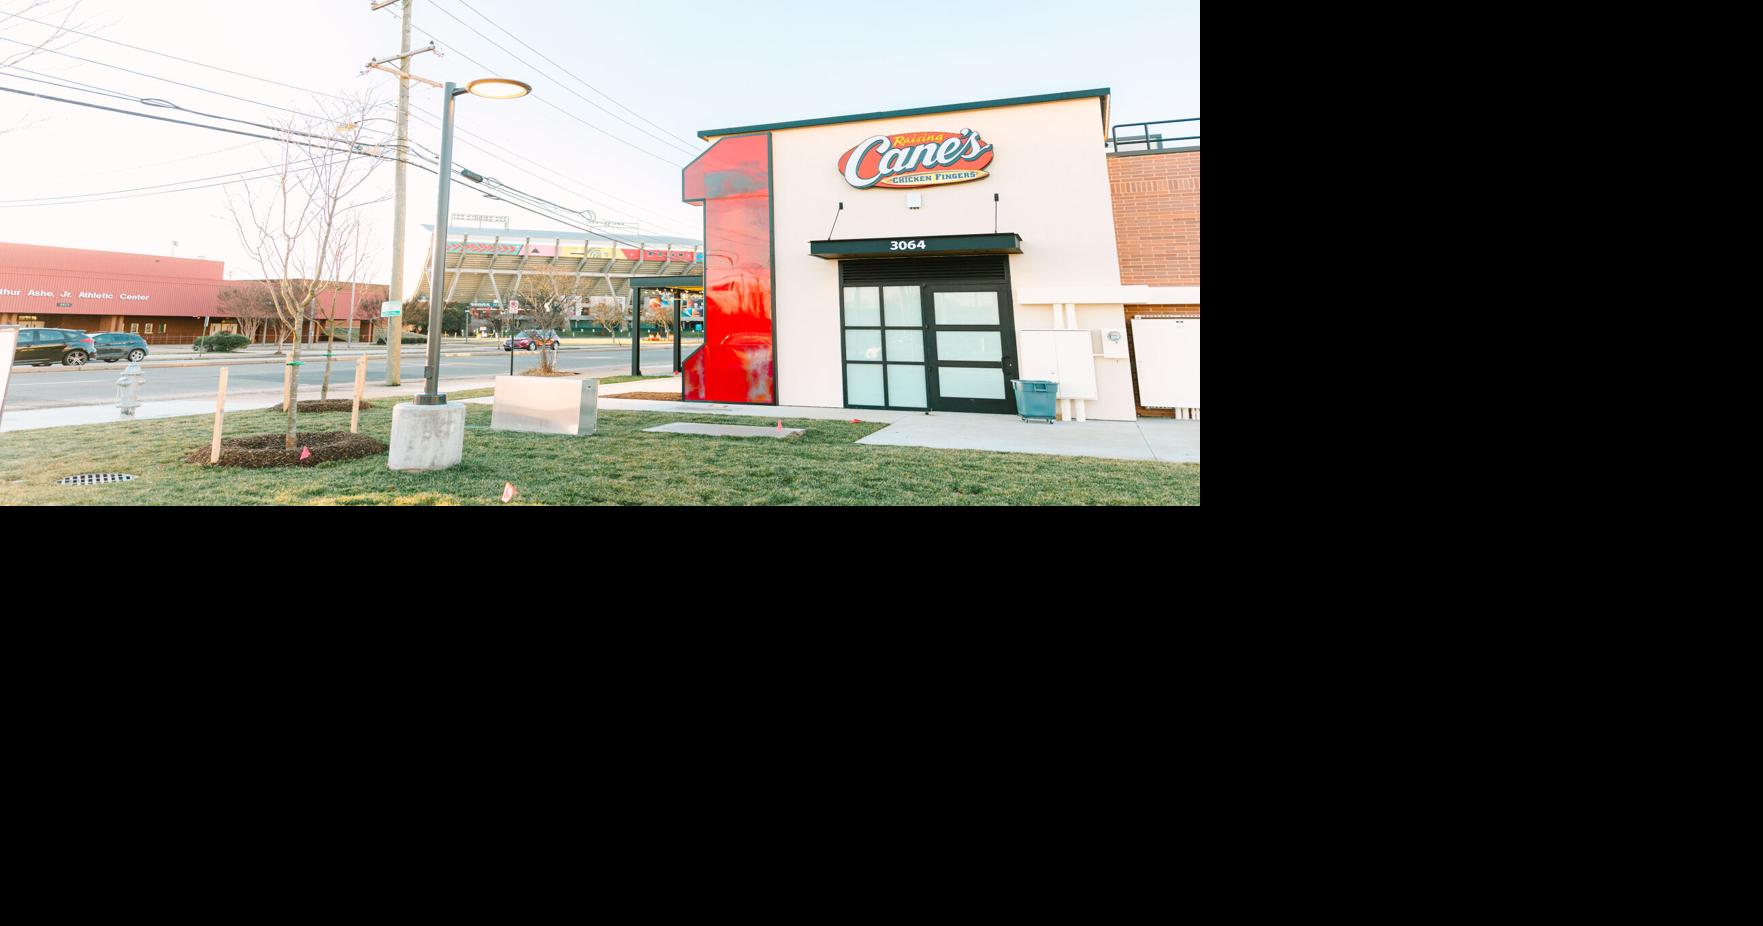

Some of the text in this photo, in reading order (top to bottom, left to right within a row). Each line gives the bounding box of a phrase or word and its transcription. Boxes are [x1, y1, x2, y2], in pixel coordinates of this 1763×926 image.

[893, 133, 943, 147] Raising
[844, 128, 993, 188] Cane's
[892, 173, 932, 184] CHICKEN
[890, 240, 926, 250] 3064
[79, 291, 113, 299] Athletic
